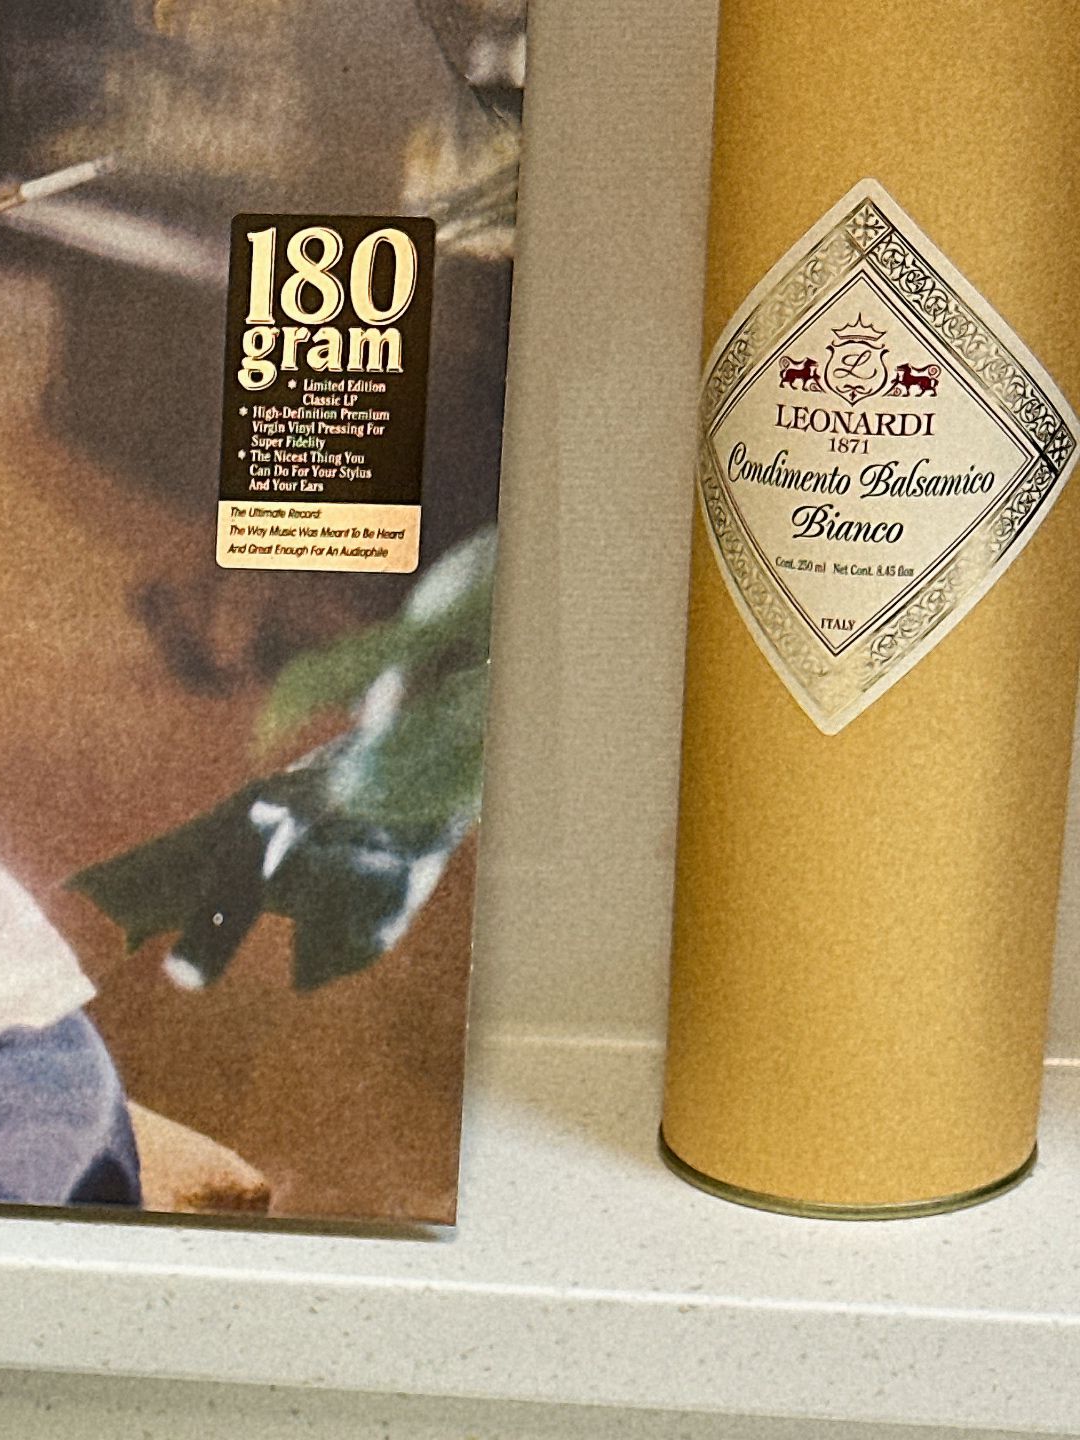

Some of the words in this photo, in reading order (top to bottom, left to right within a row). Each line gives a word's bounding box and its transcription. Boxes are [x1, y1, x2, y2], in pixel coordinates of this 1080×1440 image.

[245, 226, 418, 325] 180
[237, 325, 404, 391] gram
[303, 378, 345, 392] Limited
[347, 379, 387, 393] Edition
[302, 393, 341, 406] Classic
[343, 394, 358, 407] LP
[252, 405, 337, 421] High-Definition
[340, 408, 390, 421] Premium
[774, 403, 937, 436] LEONARDI
[252, 421, 286, 436] Virgin
[288, 421, 315, 436] Vinyl
[318, 422, 364, 438] Pressing
[367, 423, 385, 436] For
[251, 435, 283, 450] Super
[286, 435, 326, 450] Fidelity
[828, 437, 870, 455] 1871
[250, 450, 270, 462] The
[273, 450, 307, 463] Nicest
[310, 450, 342, 466] Thing
[344, 451, 365, 464] You
[249, 464, 270, 477] Can
[273, 464, 289, 477] Do
[291, 464, 310, 478] For
[311, 465, 338, 478] Your
[339, 466, 372, 481] Stylus
[727, 441, 851, 496] Condimento
[859, 458, 995, 500] Balsamico
[249, 478, 270, 491] And
[272, 478, 298, 492] Your
[300, 479, 324, 492] Ears
[231, 506, 246, 517] The
[248, 507, 286, 519] Ultimate
[791, 503, 905, 543] Bianco
[229, 524, 245, 536] The
[248, 525, 267, 538] Way
[269, 525, 297, 537] Music
[298, 526, 318, 537] Was
[320, 526, 350, 538] Meant
[351, 527, 360, 538] To
[362, 528, 375, 539] Be
[377, 528, 406, 540] Heard
[227, 543, 247, 554] And
[248, 544, 273, 555] Great
[275, 544, 308, 557] Enough
[310, 545, 325, 556] For
[326, 545, 338, 556] An
[340, 546, 389, 559] Audiophile
[797, 559, 813, 572] 250
[814, 562, 826, 573] ml
[833, 563, 848, 575] Net
[876, 565, 896, 577] 8.45
[821, 617, 856, 630] ITALY
